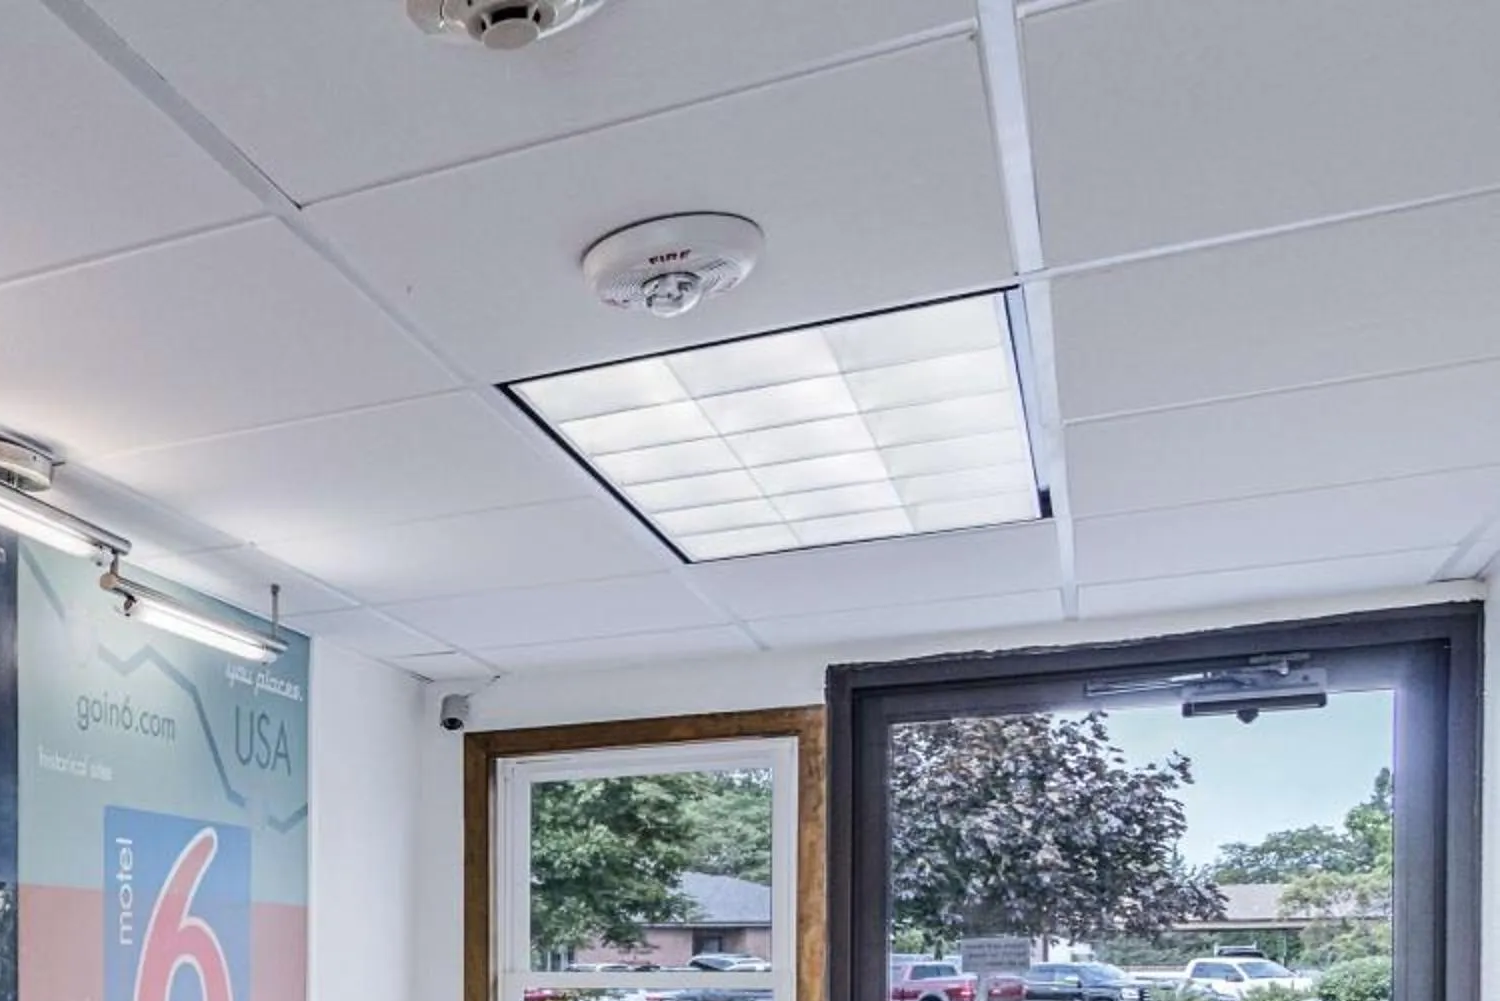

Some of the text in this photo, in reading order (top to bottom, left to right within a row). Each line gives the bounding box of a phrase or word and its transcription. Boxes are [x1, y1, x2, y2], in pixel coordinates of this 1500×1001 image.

[76, 693, 176, 742] goin6.com
[235, 704, 292, 776] USA
[116, 837, 133, 945] motel
